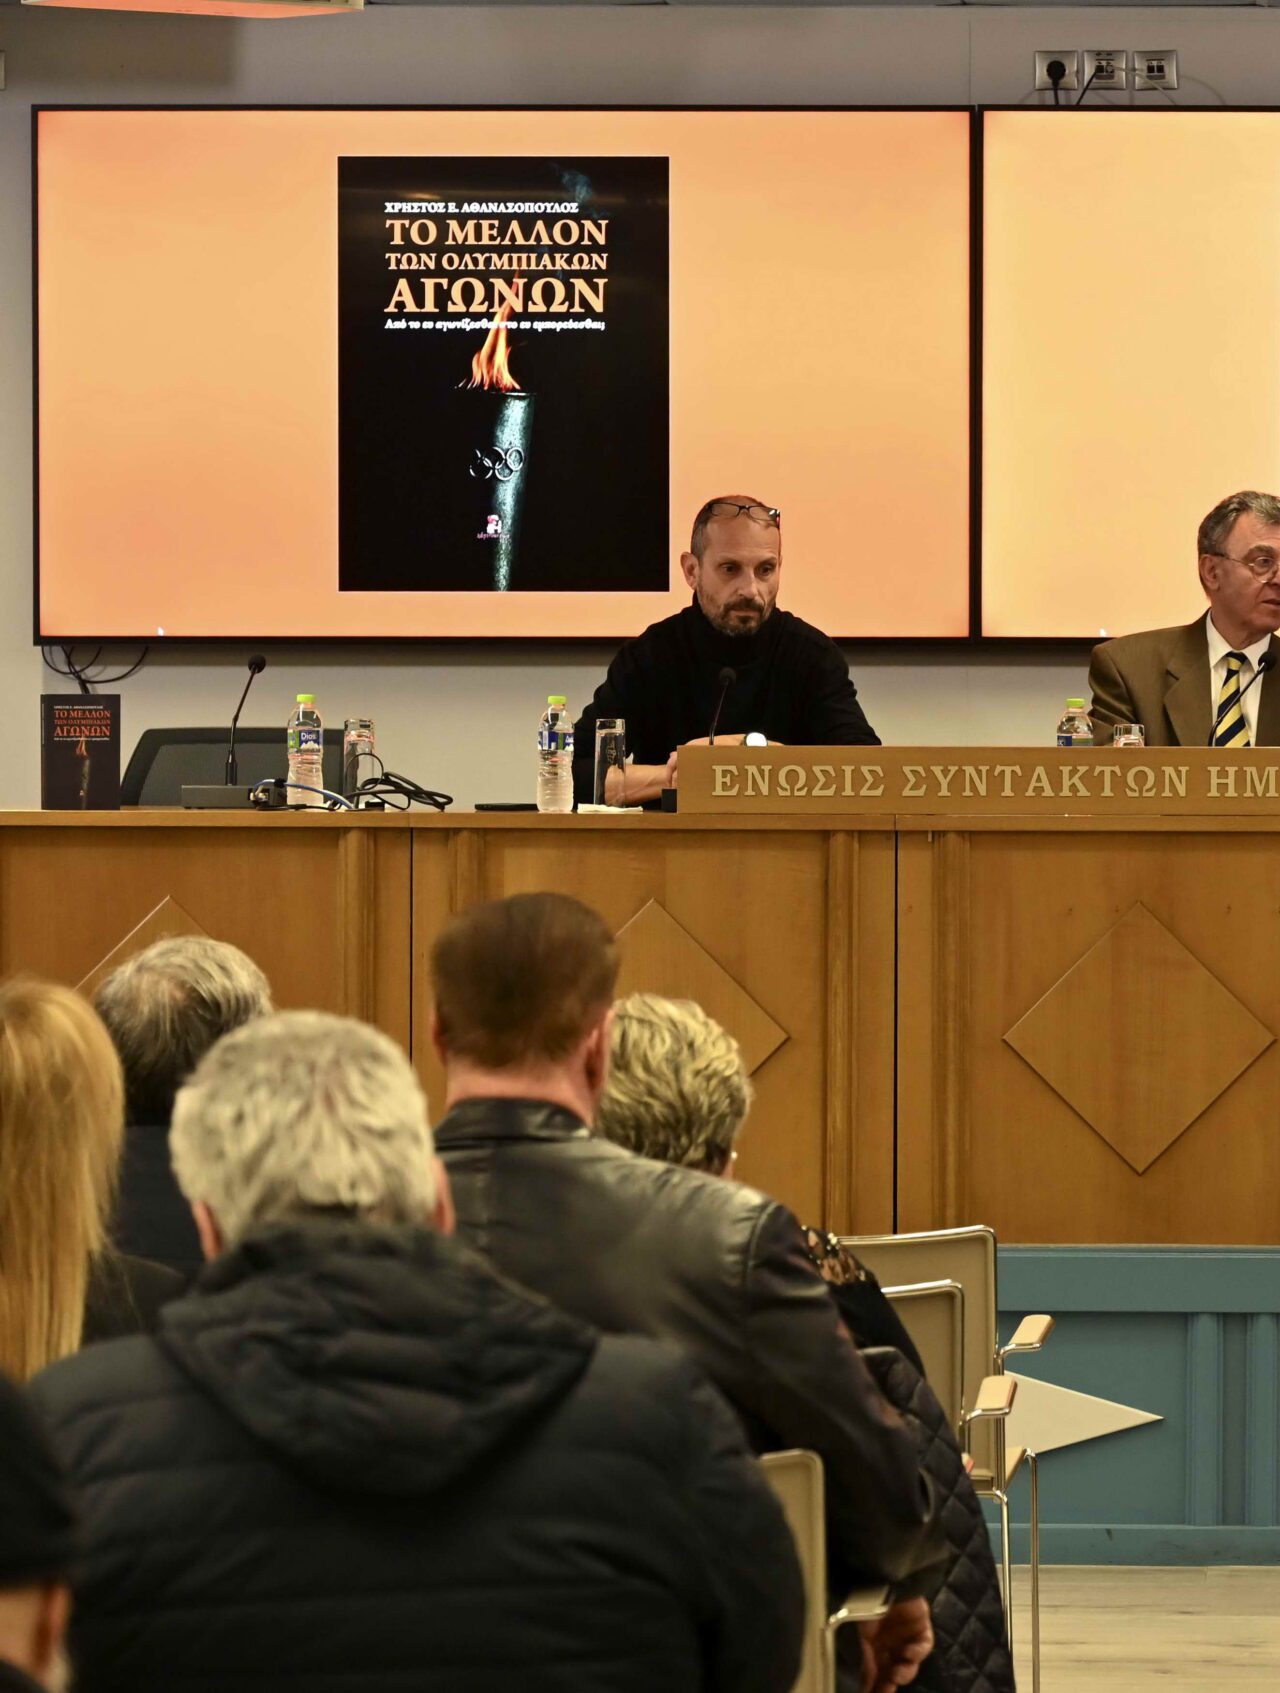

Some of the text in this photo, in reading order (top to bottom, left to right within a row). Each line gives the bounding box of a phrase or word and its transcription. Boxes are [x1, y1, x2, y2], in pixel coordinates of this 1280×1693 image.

[385, 202, 579, 213] ΧΡΗΣΤΟΣ Ε. ΑΘΑΝΑΣΟΠΟΥΛΟΣ
[386, 219, 608, 245] ΤΟ ΜΕΛΛΟΝ
[386, 253, 608, 270] ΤΩΝ ΟΛΥΜΠΙΑΚΩΝ
[384, 278, 608, 312] ΑΓΩΝΩΝ
[385, 319, 407, 330] Από
[409, 321, 420, 329] το
[70, 710, 110, 718] ΜΕΛΛΟΝ
[54, 726, 110, 736] ΑΓΩΝΩΝ
[712, 764, 884, 796] ΕΝΩΣΙΣ
[901, 765, 1189, 797] ΣΥΝΤΑΚΤΩΝ
